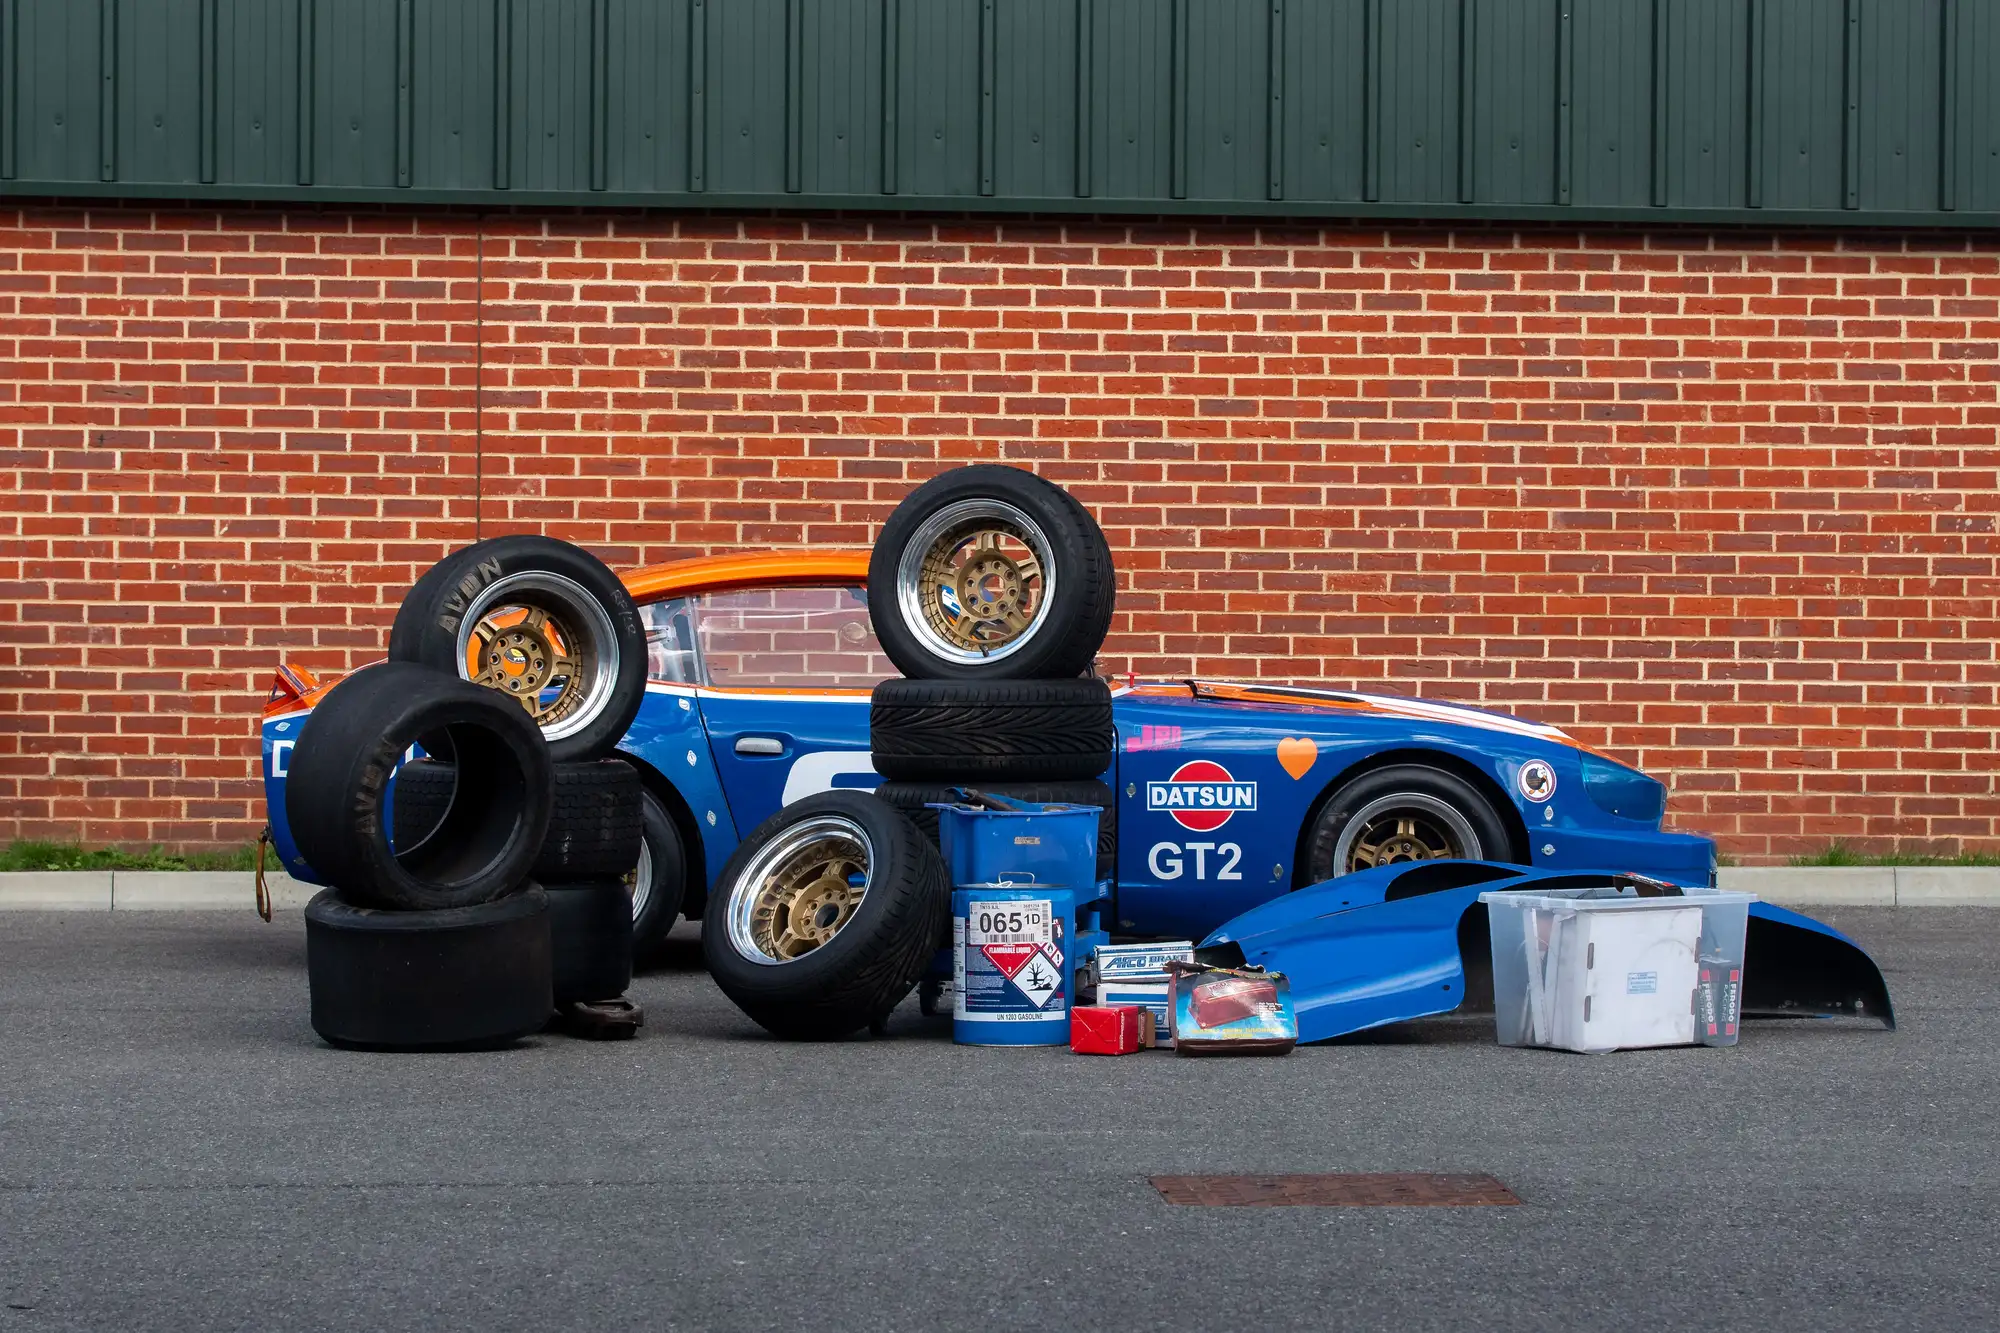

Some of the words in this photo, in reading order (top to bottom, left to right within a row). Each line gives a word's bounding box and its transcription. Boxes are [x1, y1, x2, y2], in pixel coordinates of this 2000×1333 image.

[1151, 788, 1252, 807] DATSUN
[1148, 843, 1242, 880] GT2
[979, 912, 1023, 933] 065
[1024, 913, 1041, 925] 1D
[988, 946, 1016, 954] FLAMMABLE
[1016, 946, 1031, 954] LIQUID
[1104, 956, 1147, 969] AFCO
[1149, 954, 1188, 964] BRAKE
[1702, 983, 1714, 1023] FERODO
[1728, 983, 1737, 1022] FERODO
[996, 1013, 1005, 1021] UN
[1017, 1012, 1043, 1020] GASOLINE
